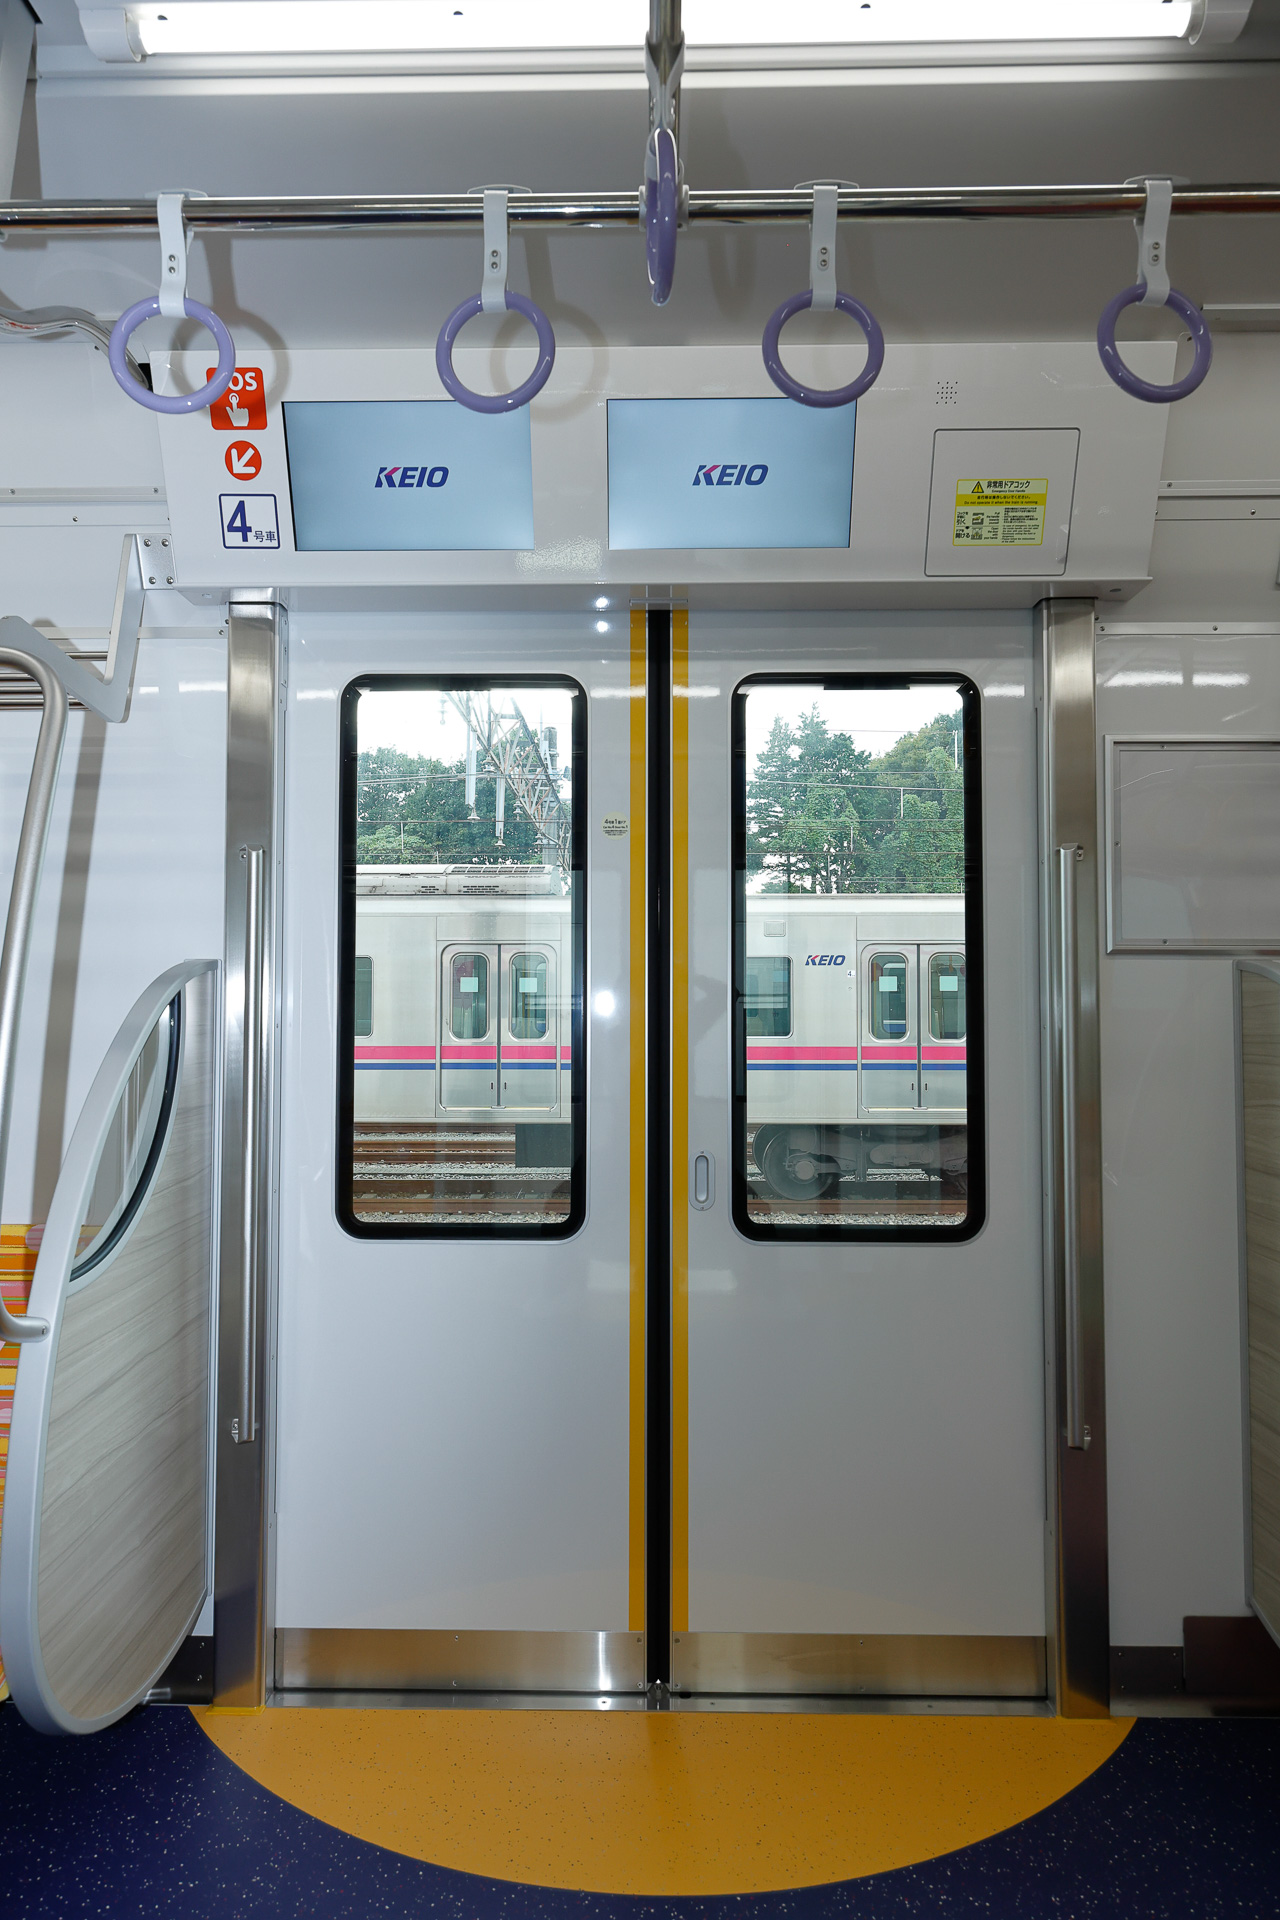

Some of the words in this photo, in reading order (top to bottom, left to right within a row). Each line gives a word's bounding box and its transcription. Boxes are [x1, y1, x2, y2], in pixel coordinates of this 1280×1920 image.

[228, 372, 258, 391] OS
[375, 466, 449, 488] KEIO
[692, 464, 768, 486] KEIO
[805, 955, 846, 966] KEIO
